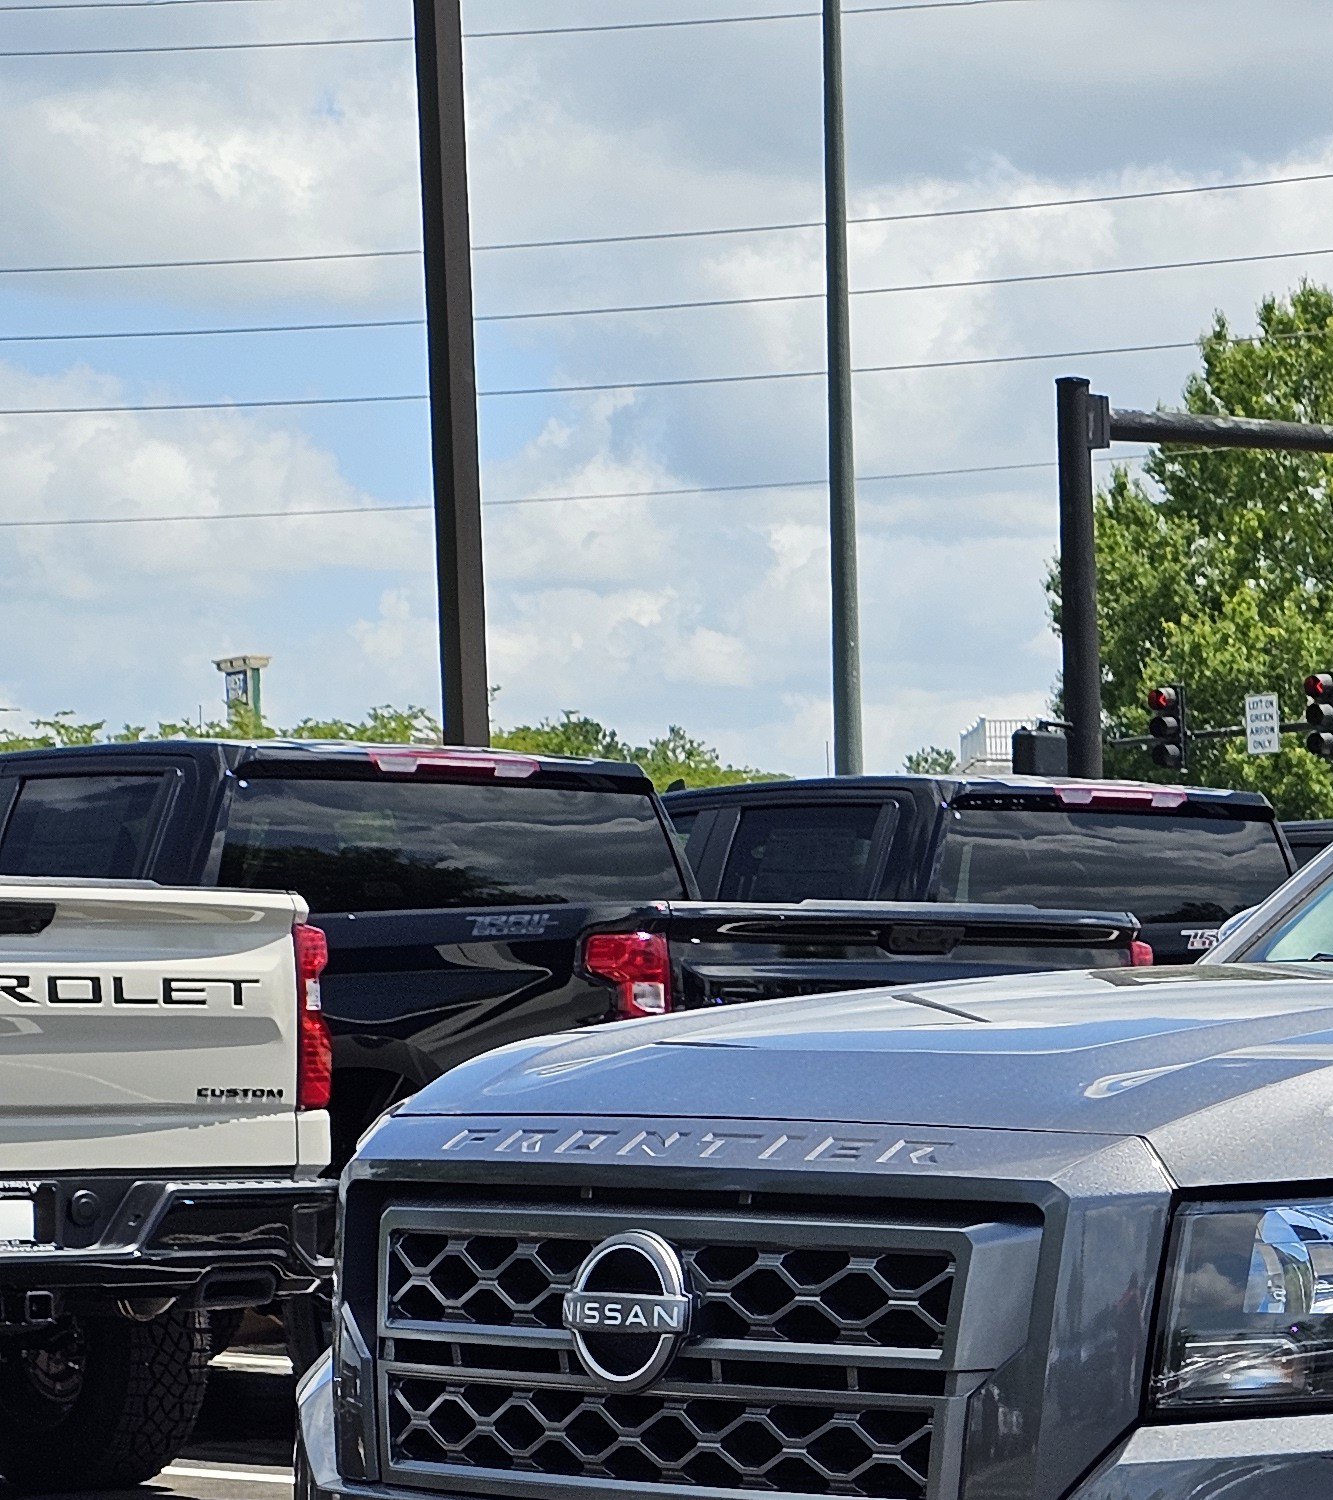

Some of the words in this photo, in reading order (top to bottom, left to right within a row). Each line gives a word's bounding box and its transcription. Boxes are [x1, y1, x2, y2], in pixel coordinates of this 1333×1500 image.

[1248, 699, 1262, 710] LEFT
[1264, 700, 1274, 709] ON
[1249, 713, 1274, 723] GREEN
[1250, 726, 1275, 736] ARROW
[1252, 739, 1272, 750] ONLY
[197, 1086, 284, 1099] CUSTOM
[441, 1128, 955, 1166] FRONTIER
[562, 1301, 679, 1328] NISSAN
